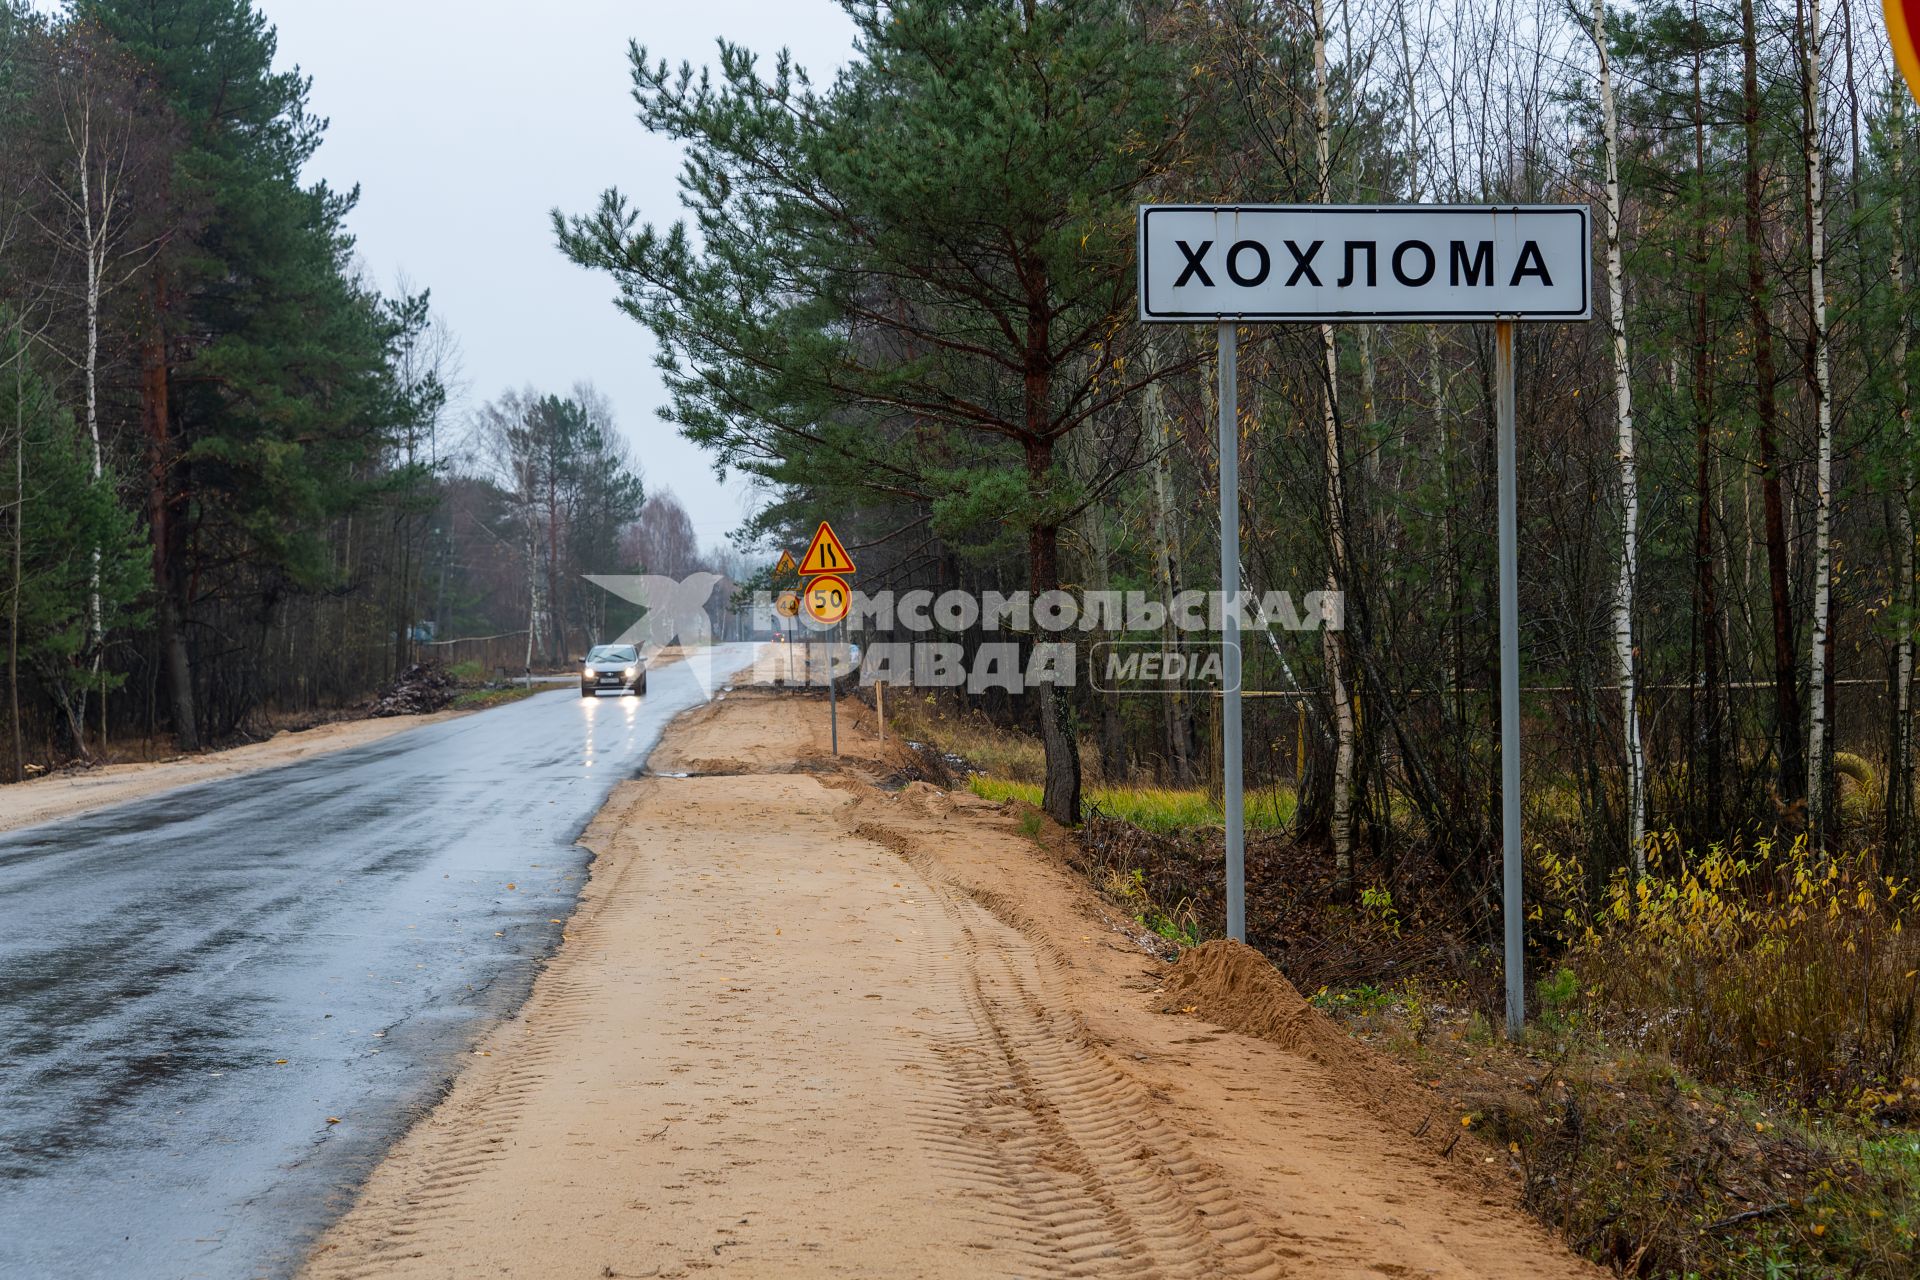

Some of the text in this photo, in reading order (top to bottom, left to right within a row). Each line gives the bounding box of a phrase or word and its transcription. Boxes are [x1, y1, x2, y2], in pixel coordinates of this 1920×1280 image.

[1173, 239, 1554, 287] ХОХЛОМА
[780, 599, 796, 611] 40
[814, 589, 843, 609] 50
